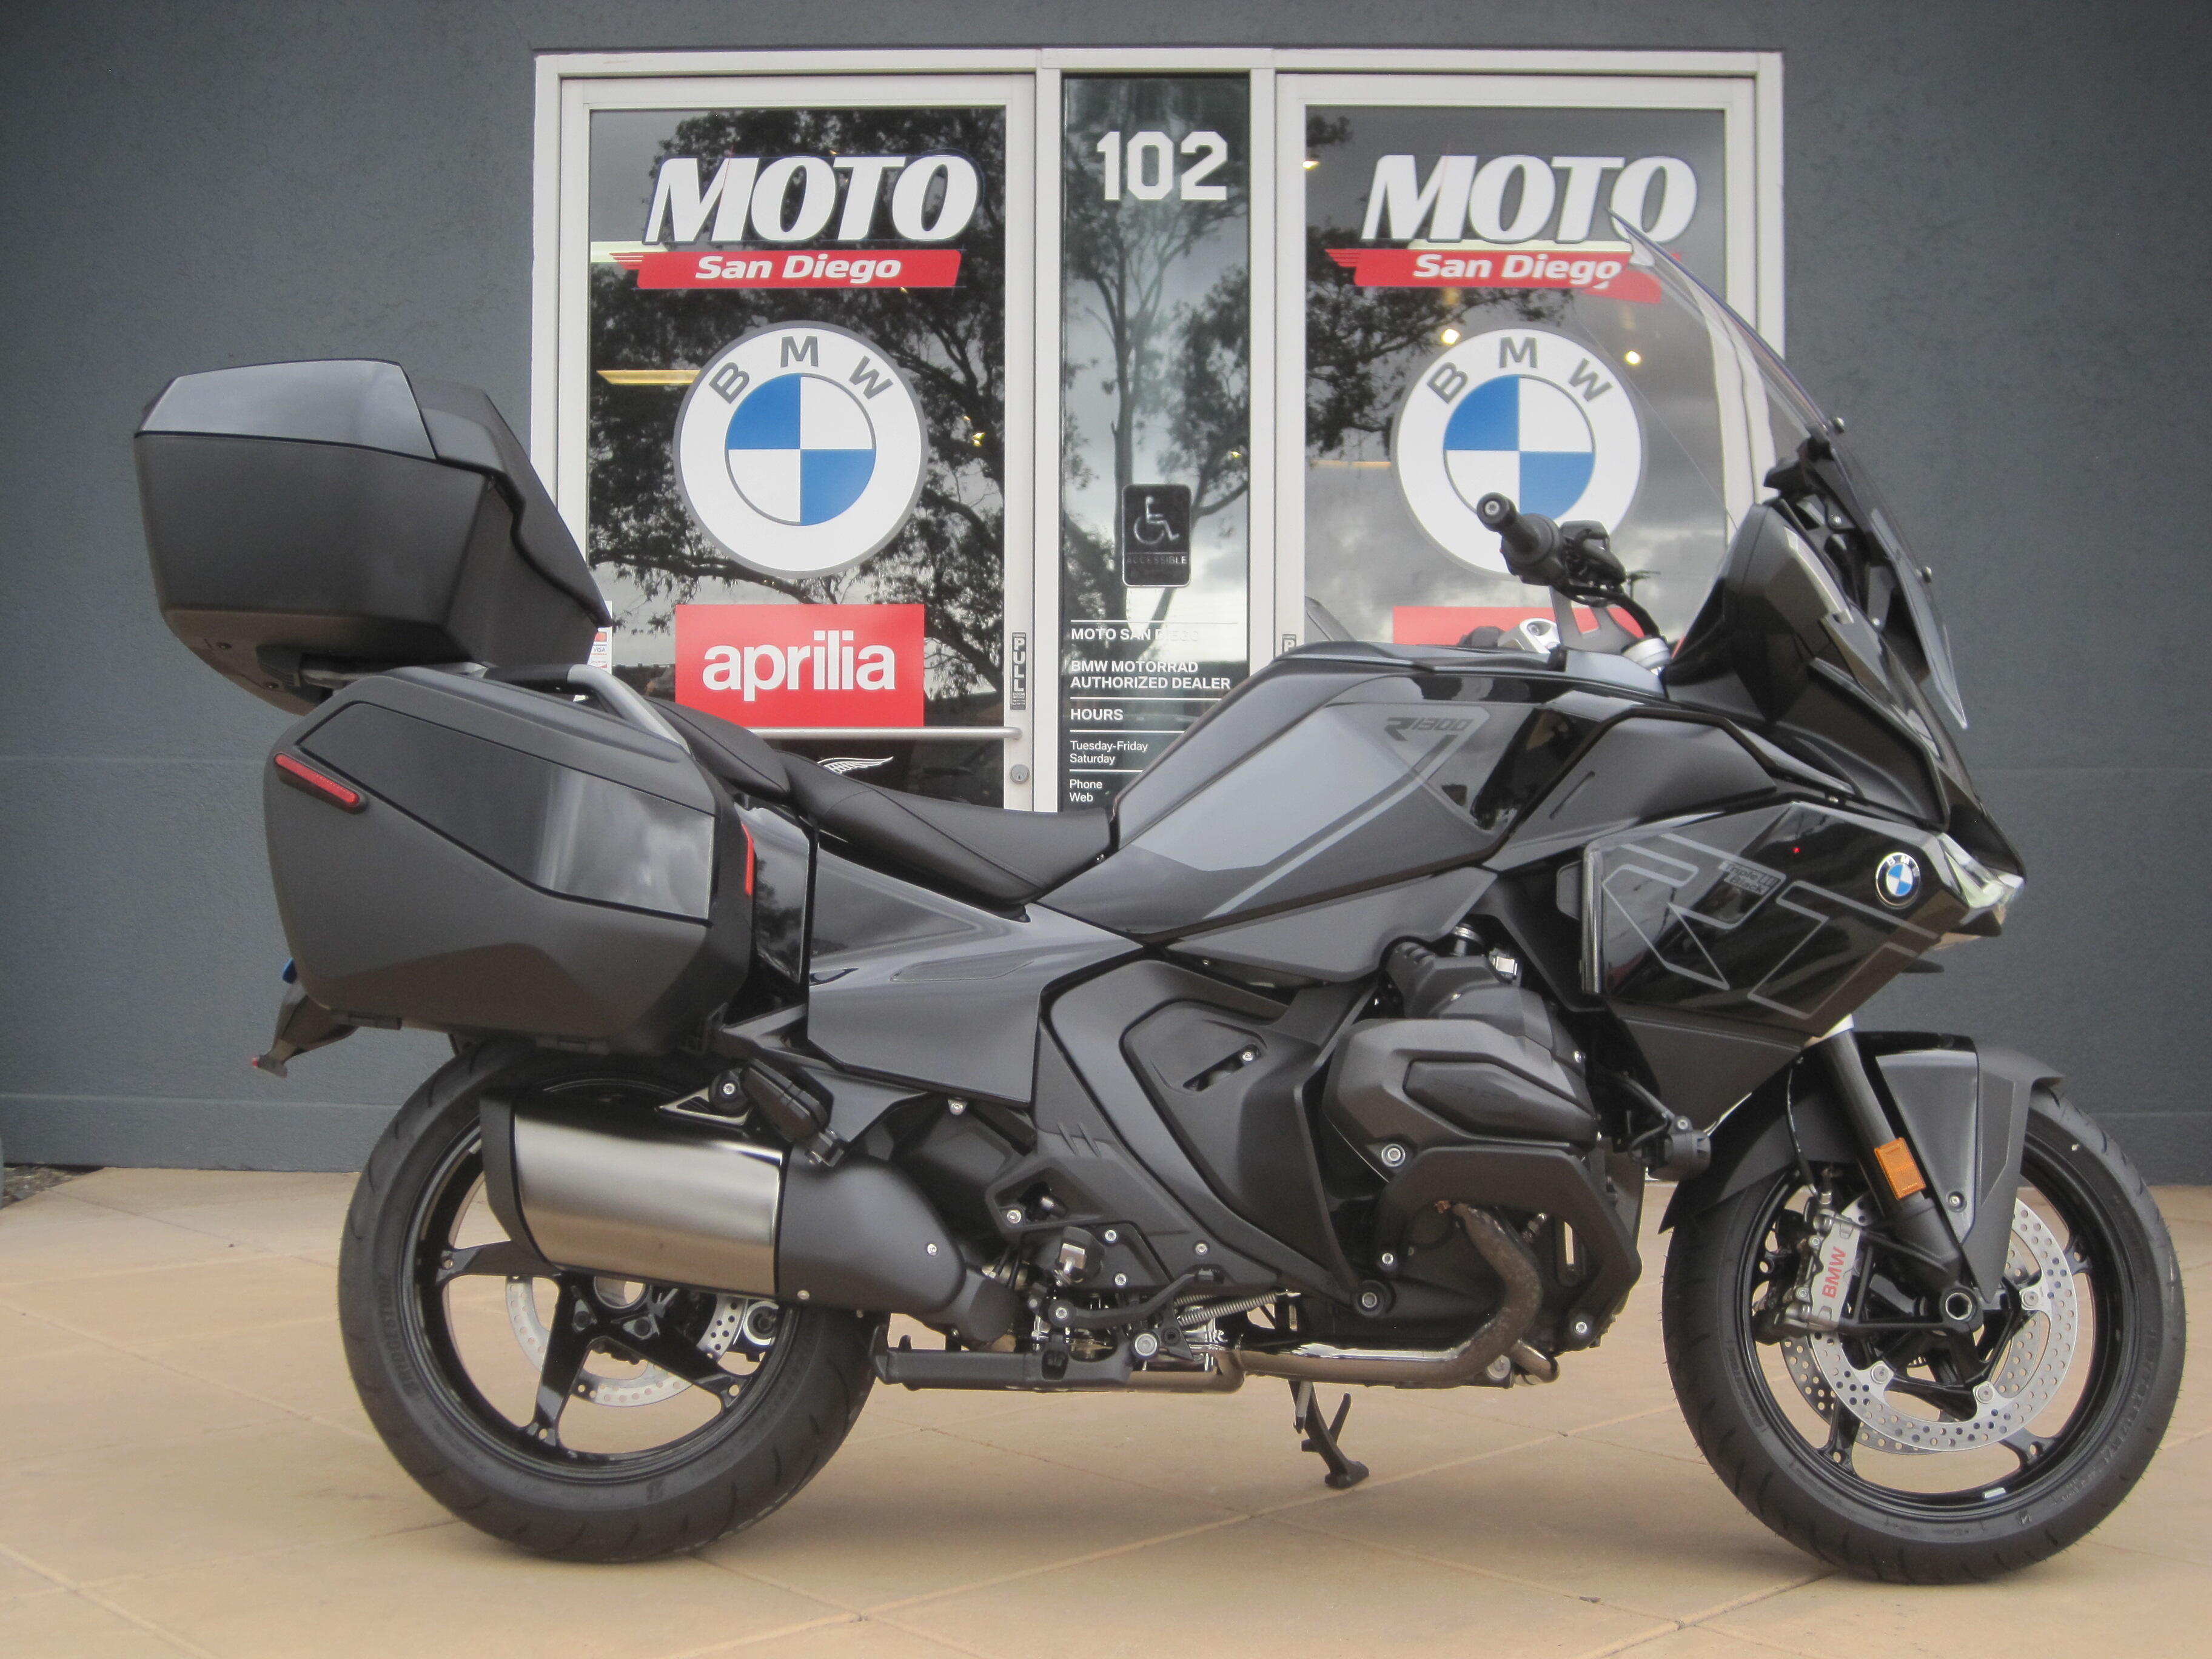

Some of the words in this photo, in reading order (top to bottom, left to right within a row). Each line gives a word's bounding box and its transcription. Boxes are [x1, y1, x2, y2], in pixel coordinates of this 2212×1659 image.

[1097, 132, 1228, 200] 102
[643, 155, 978, 243] MOTO
[1360, 155, 1697, 243] MOTO
[695, 255, 770, 279] San
[782, 253, 902, 284] Diego
[1413, 254, 1489, 279] San
[1501, 254, 1621, 287] Diego
[709, 335, 893, 404] BMW
[1427, 336, 1614, 405] BMW
[1071, 628, 1116, 640] MOTO
[1120, 629, 1151, 640] SAN
[702, 629, 896, 702] aprilia
[1013, 637, 1025, 692] PULL
[1071, 660, 1108, 672] BMW
[1111, 661, 1199, 673] MOTORRAD
[1070, 676, 1168, 689] AUTHORIZED
[1171, 677, 1232, 690] DEALER
[1070, 708, 1124, 721] HOURS
[1070, 740, 1148, 752] Tuesday-Friday
[1070, 753, 1116, 766] Saturday
[1069, 792, 1094, 802] Web
[1070, 779, 1102, 789] Phone
[1886, 856, 1920, 877] BMW
[1822, 1246, 1846, 1298] BMW
